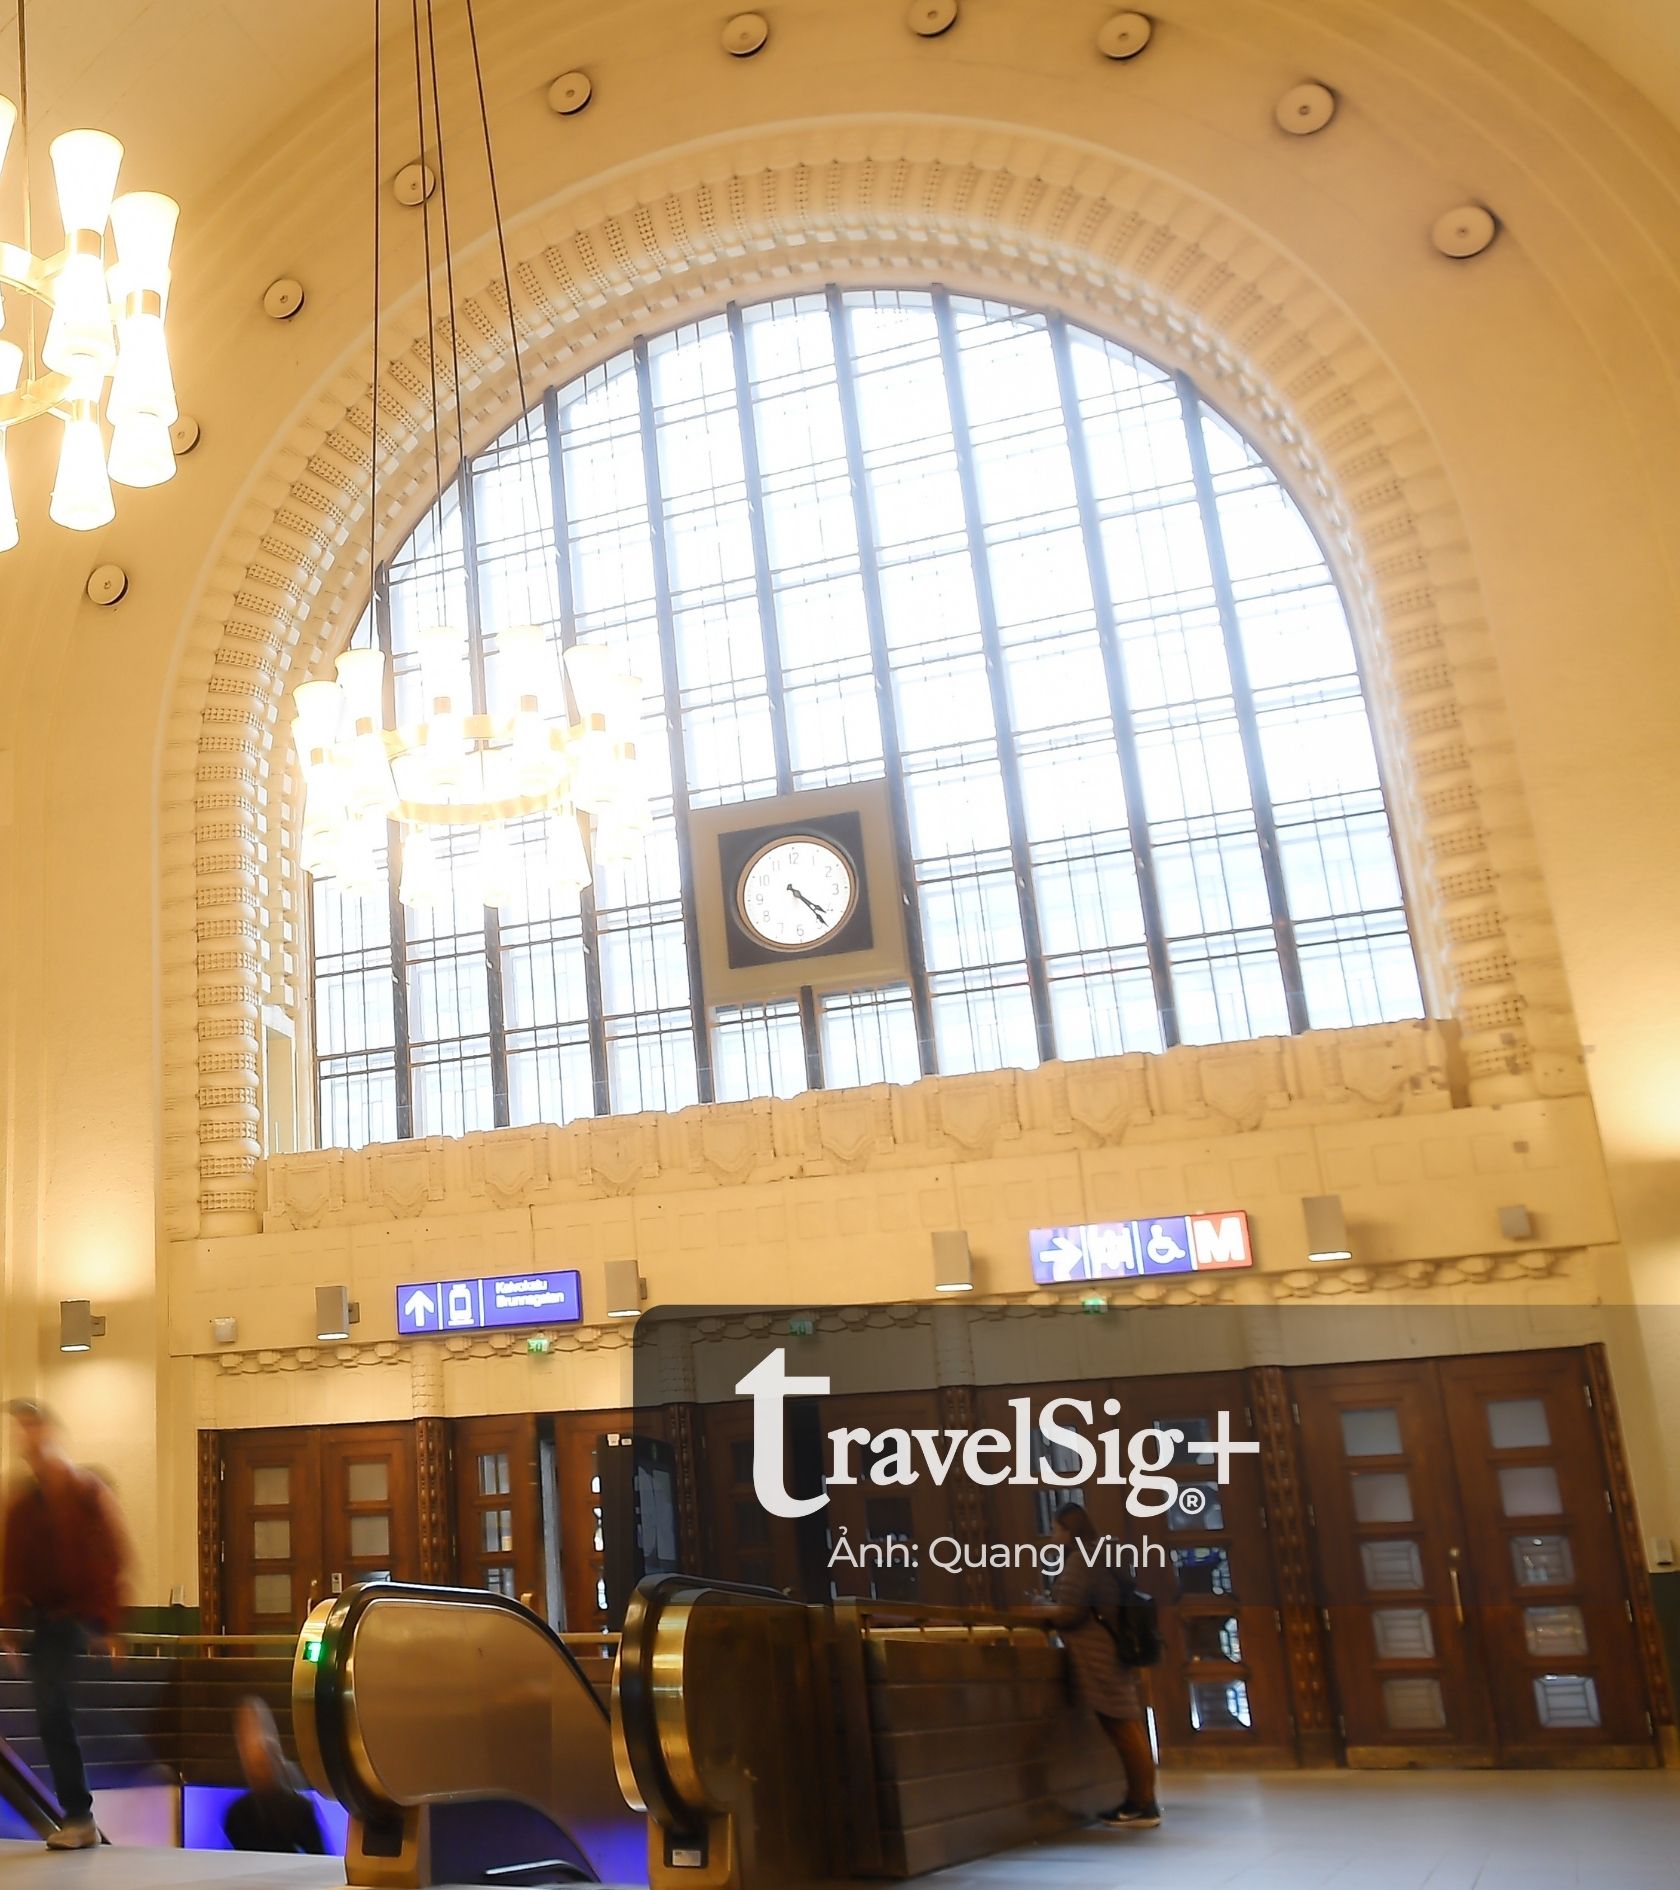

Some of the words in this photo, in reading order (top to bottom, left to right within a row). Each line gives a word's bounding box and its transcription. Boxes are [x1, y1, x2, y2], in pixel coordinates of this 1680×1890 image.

[789, 852, 799, 864] 12
[825, 866, 832, 878] 2
[759, 874, 769, 886] 10
[832, 883, 839, 895] 3
[756, 894, 763, 905] 9
[763, 911, 770, 923] 8
[797, 924, 804, 936] 6
[1194, 1216, 1247, 1263] M
